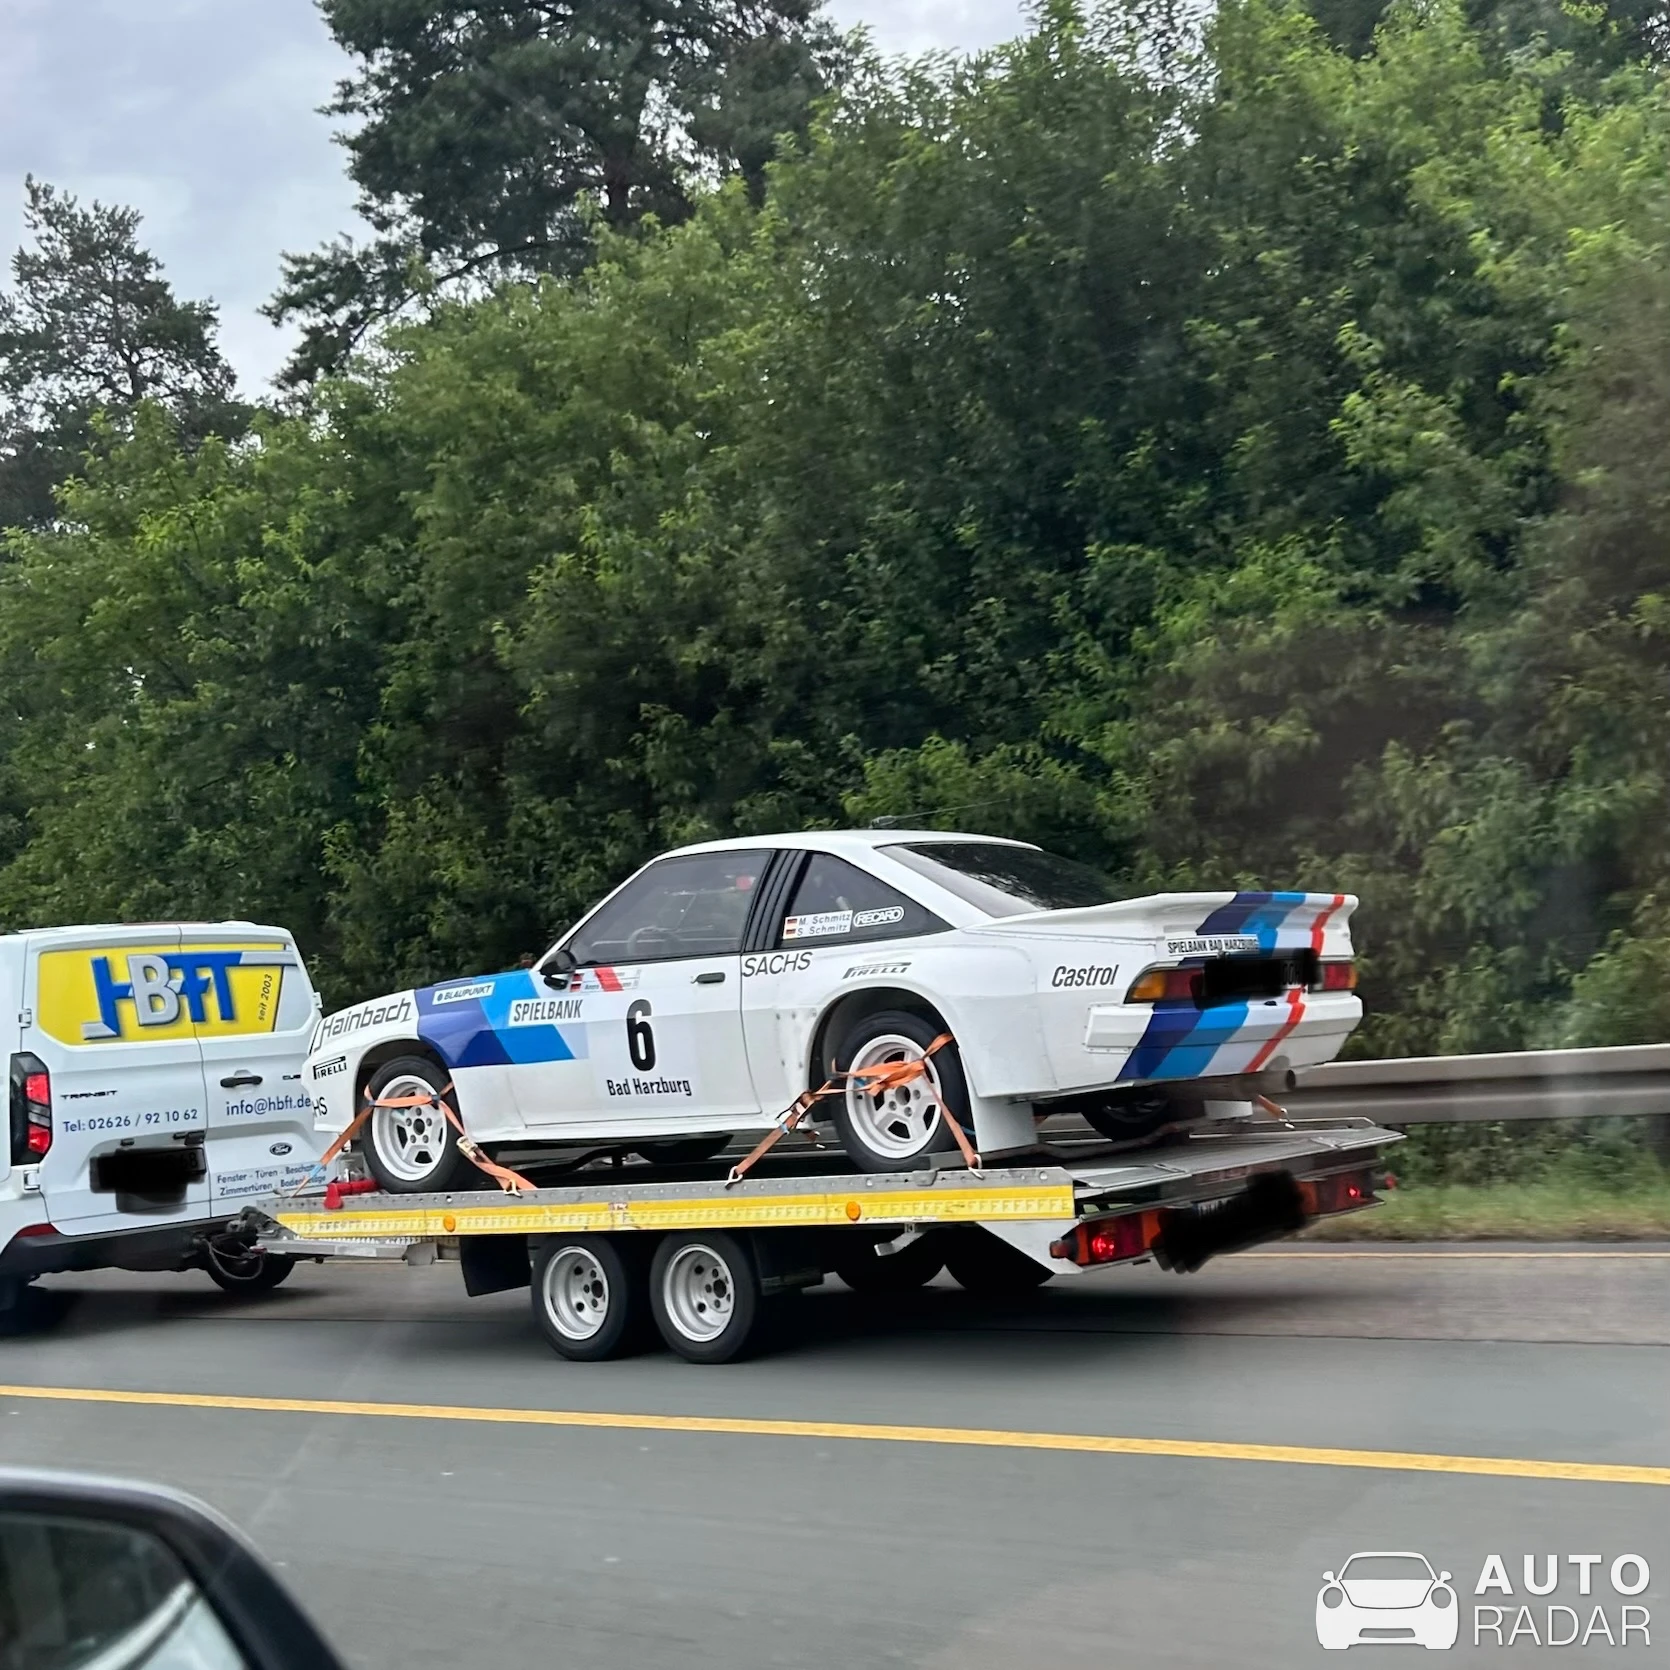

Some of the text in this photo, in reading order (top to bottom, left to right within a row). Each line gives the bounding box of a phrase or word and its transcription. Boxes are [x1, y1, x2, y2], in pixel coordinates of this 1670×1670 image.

[812, 914, 850, 925] Schmitz
[856, 909, 902, 926] RECARO
[809, 924, 848, 935] Schmitz
[1167, 937, 1258, 954] SPIELBANK BAD HARZBURG
[741, 951, 813, 978] SACHS
[842, 962, 912, 980] PIRELLI
[1051, 965, 1120, 988] Castrol
[258, 973, 273, 1022] seit 2003
[444, 985, 492, 1000] BLAUPUNKT
[513, 999, 583, 1023] SPIELBANK
[313, 998, 412, 1053] Hainbach
[626, 998, 657, 1072] 6
[313, 1056, 348, 1081] PIRELLI
[60, 1089, 118, 1100] TRANSIT
[606, 1076, 693, 1097] Bad Harzburg
[226, 1093, 312, 1116] info@hbft.de
[63, 1120, 86, 1133] Tel:
[88, 1115, 131, 1131] 02626
[145, 1111, 160, 1124] 92
[165, 1110, 180, 1122] 10
[183, 1108, 198, 1120] 62
[217, 1173, 248, 1184] Fenster
[256, 1168, 278, 1180] Türen
[220, 1181, 273, 1197] Zimmertüren
